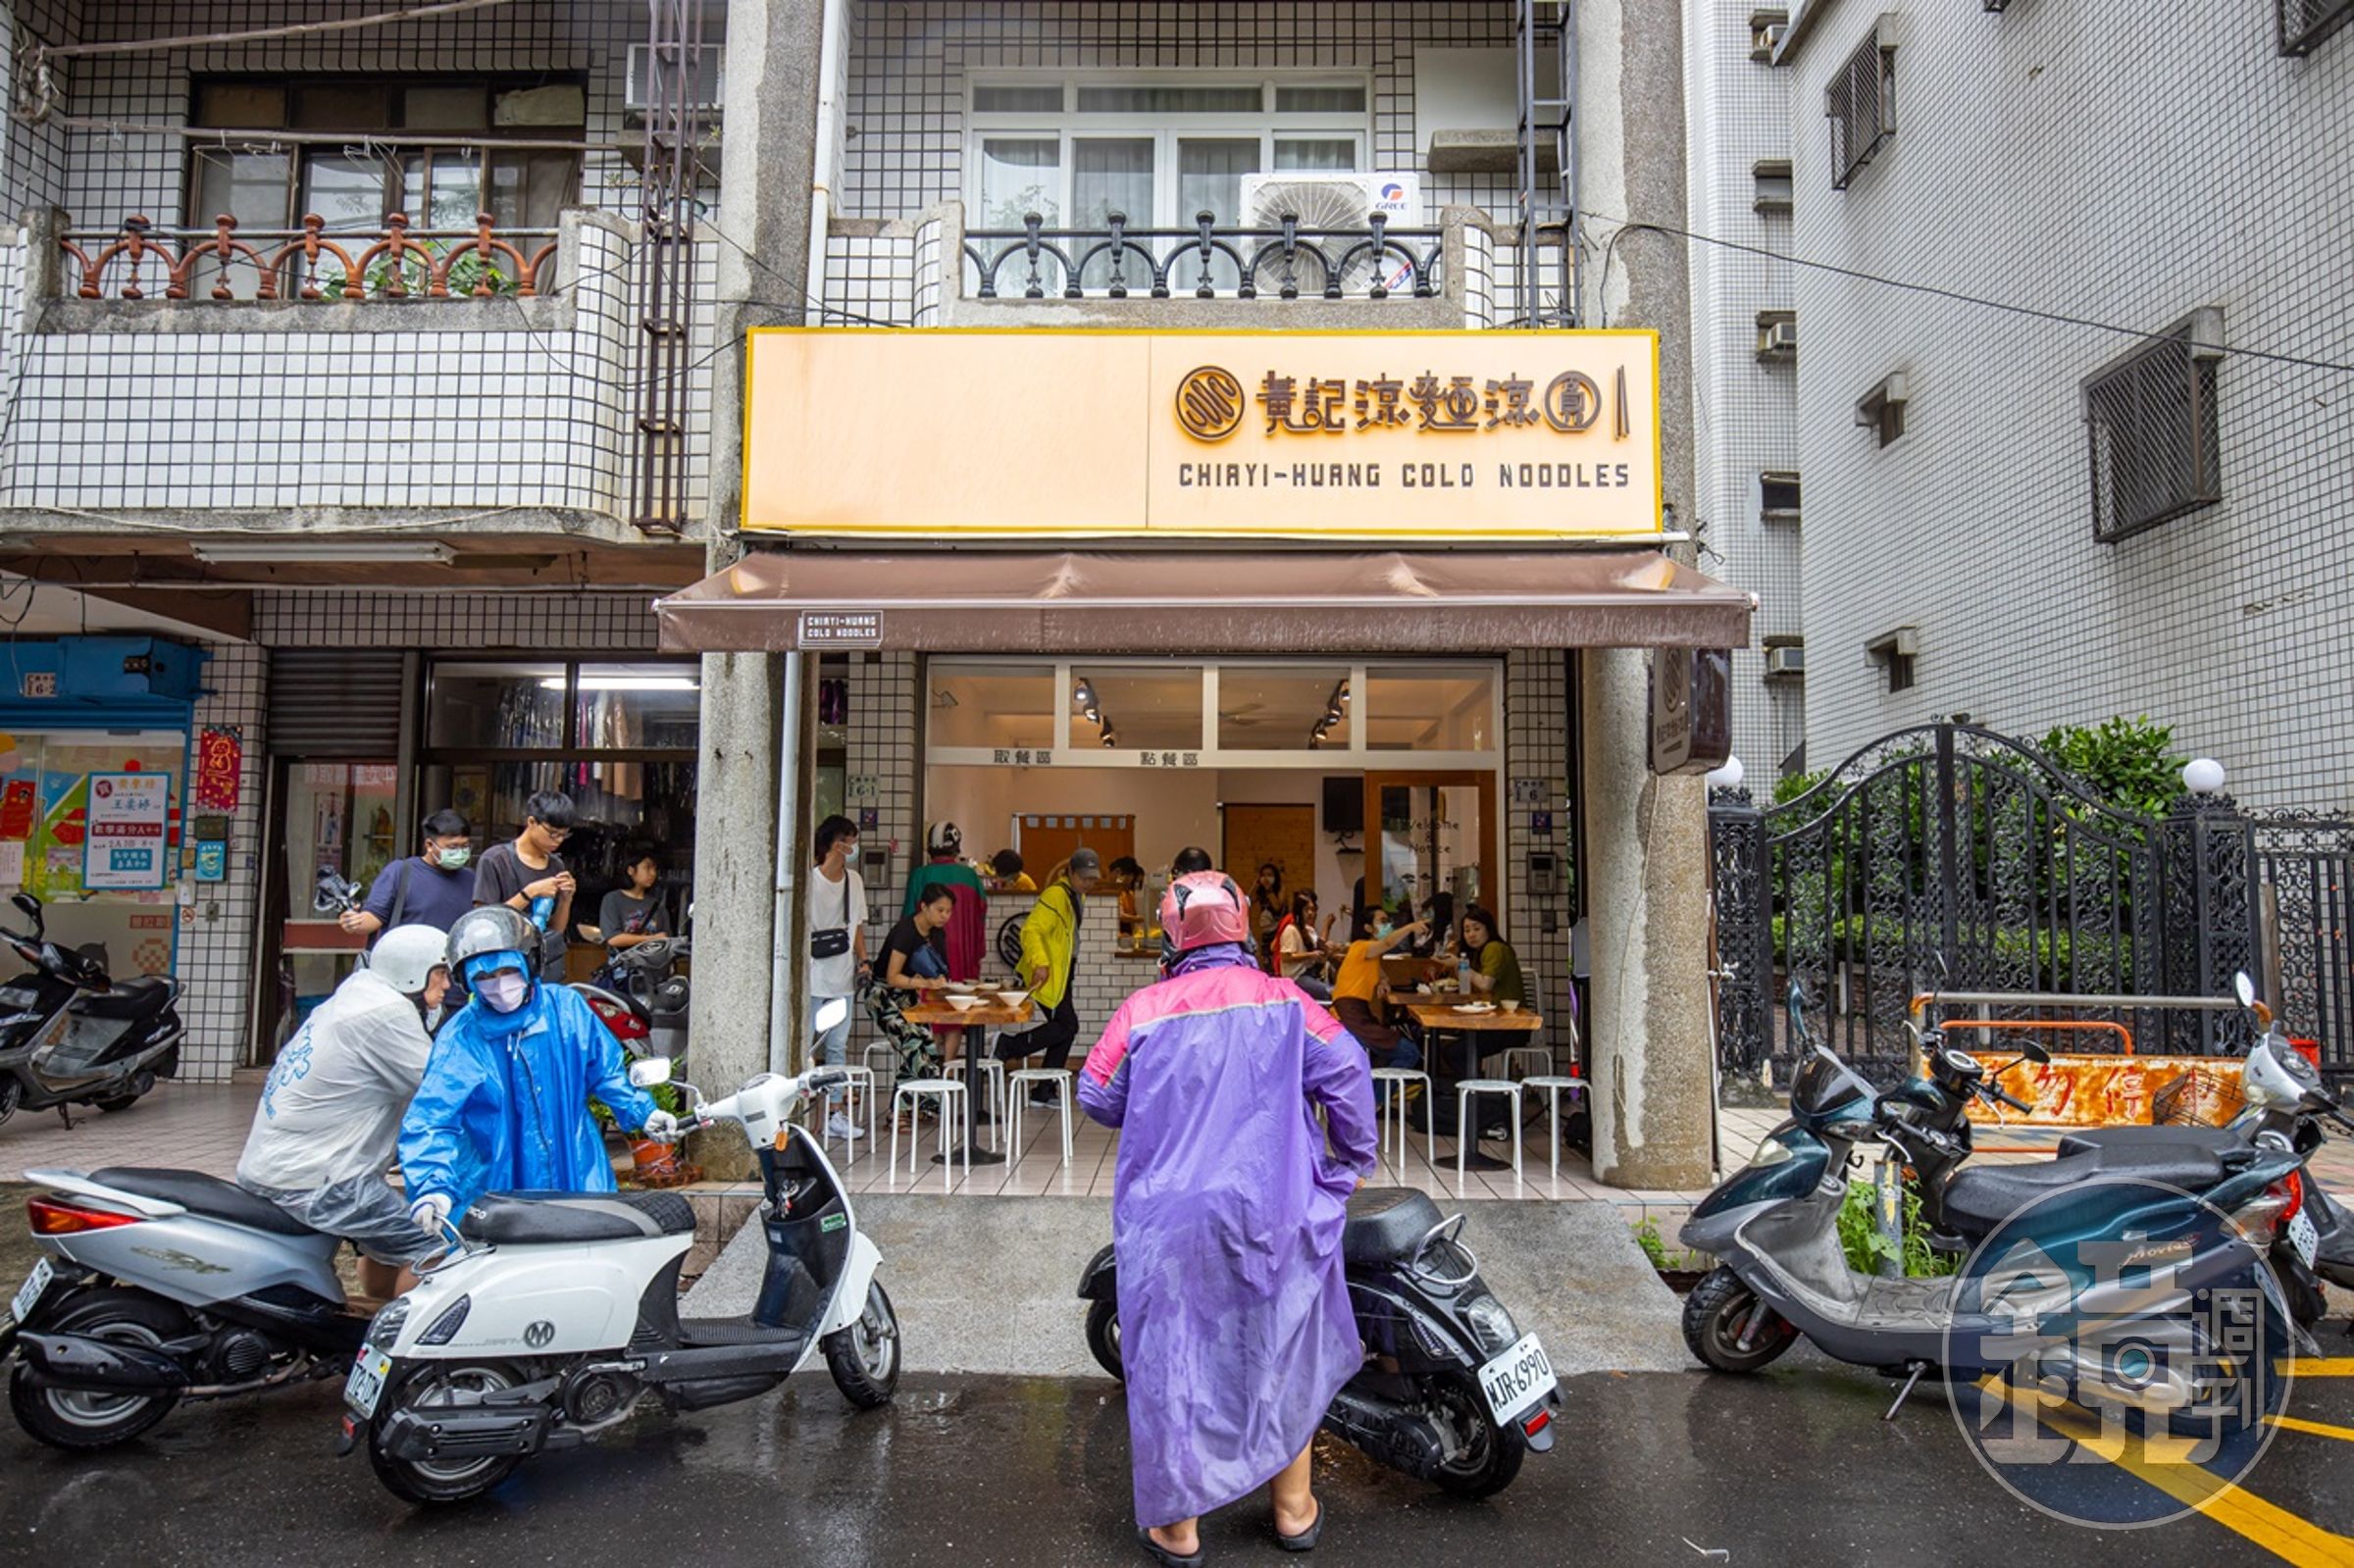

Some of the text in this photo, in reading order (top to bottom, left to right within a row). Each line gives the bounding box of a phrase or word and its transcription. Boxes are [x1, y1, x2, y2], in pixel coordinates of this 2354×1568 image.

[1375, 202, 1407, 211] GREE
[1178, 463, 1630, 488] CHIAYI-HUANG COLD NOODLES
[807, 616, 877, 627] CHIAYI-HUANG
[807, 628, 877, 638] COLD NOODLES
[994, 749, 1052, 765] 取餐區
[1140, 751, 1199, 766] 點餐區
